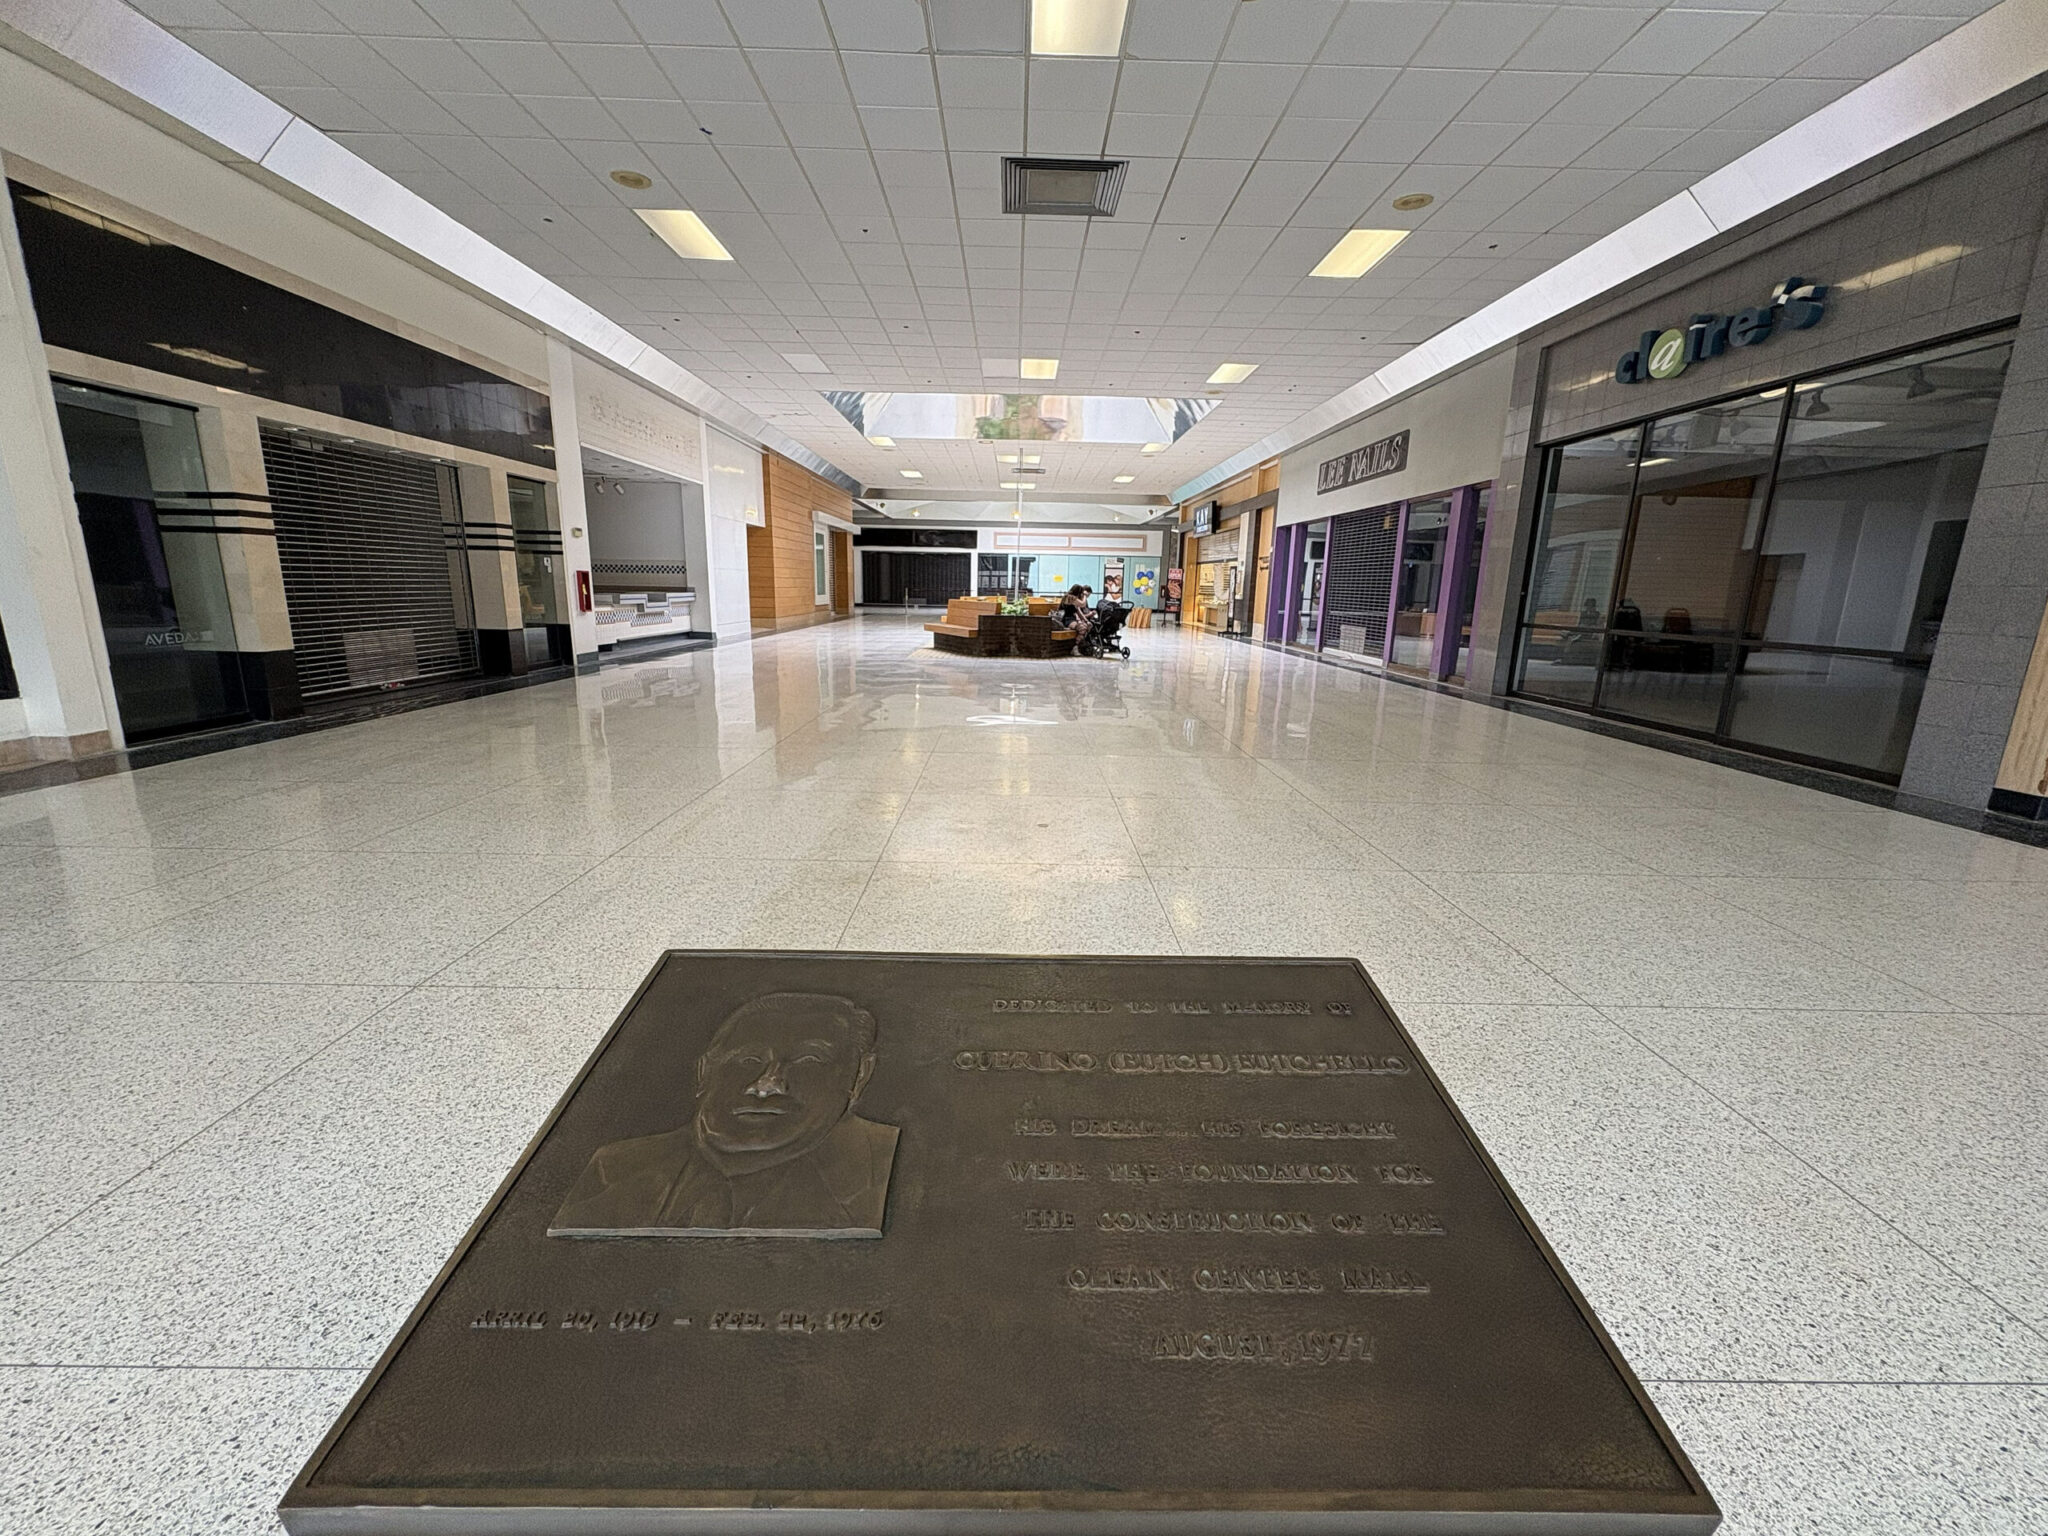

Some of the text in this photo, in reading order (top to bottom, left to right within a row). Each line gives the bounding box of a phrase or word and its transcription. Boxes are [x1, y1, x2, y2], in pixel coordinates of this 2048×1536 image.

[1616, 276, 1829, 384] claire's
[1318, 436, 1403, 491] LEE NAILS
[1196, 507, 1209, 527] KAY
[144, 632, 196, 646] AVEDA
[993, 1000, 1353, 1015] DEDICATED TO THE MEMORY OF
[1108, 1051, 1229, 1073] (BUTCH)
[1015, 1118, 1057, 1136] HIS
[1201, 1120, 1243, 1138] HIS
[1258, 1121, 1398, 1139] FORESIGHT
[1007, 1161, 1435, 1184] WERE THE FOUNDATION FOR
[1024, 1210, 1446, 1236] THE CONSTRUCTION OF THE
[1067, 1265, 1431, 1293] OLEAN CENTER MALL
[471, 1310, 548, 1329] APRIL
[1298, 1330, 1374, 1365] 1977
